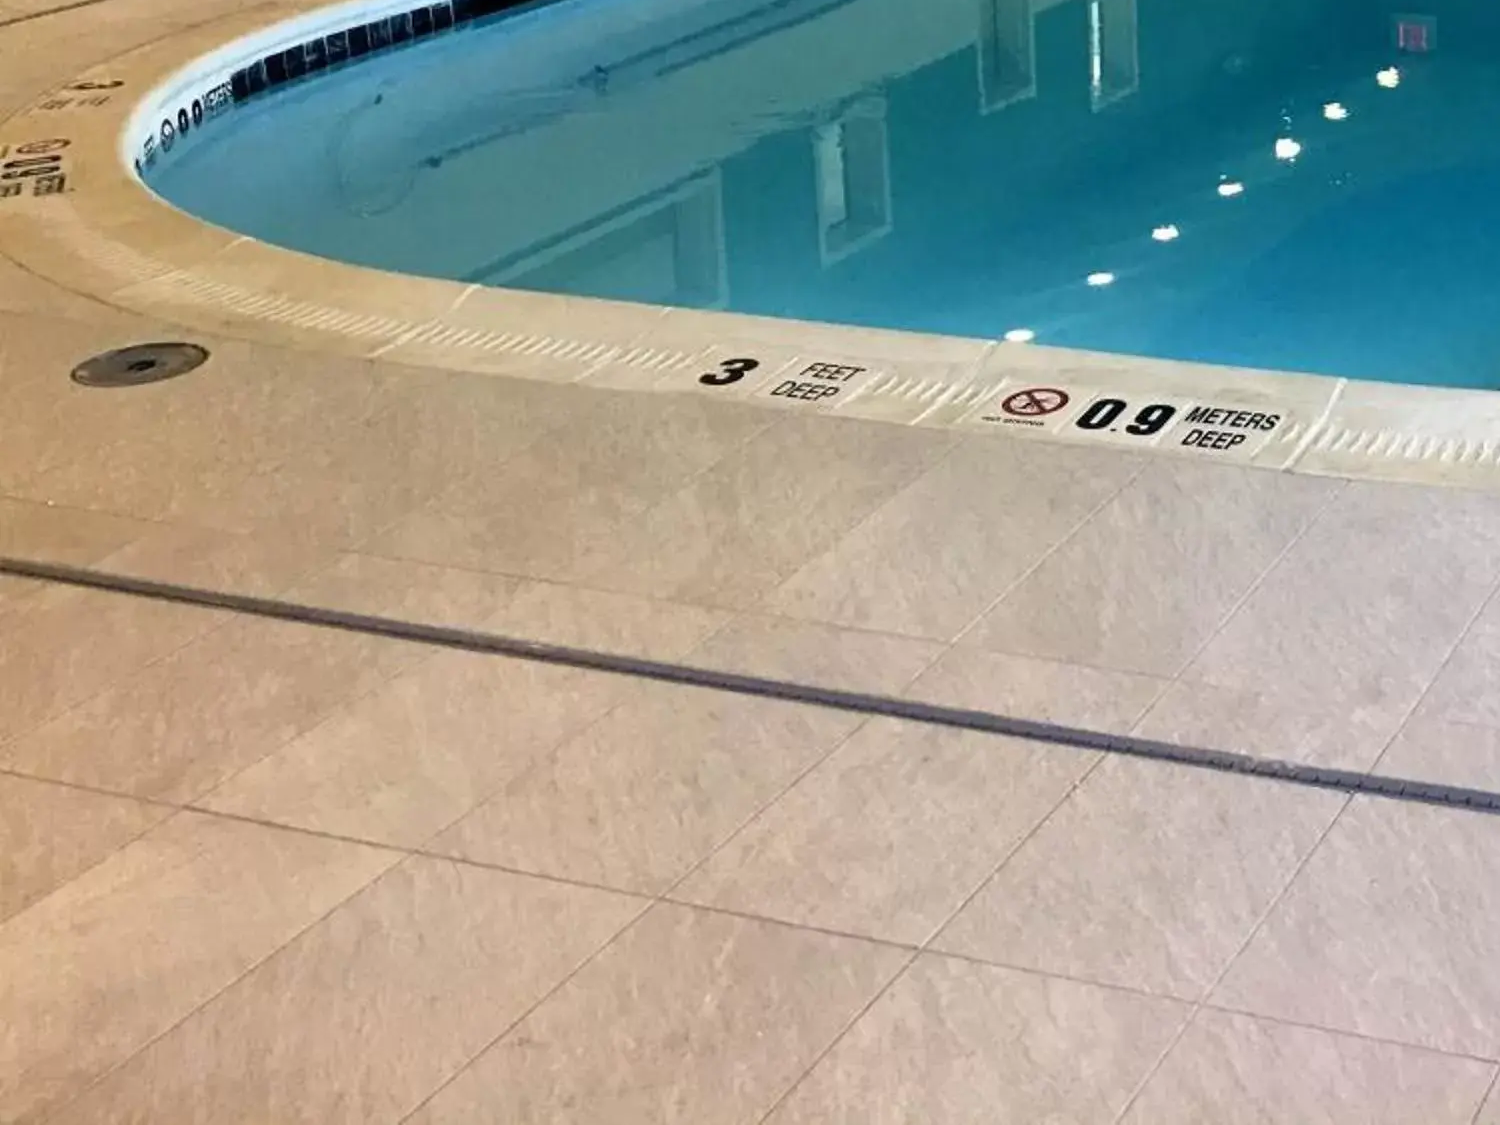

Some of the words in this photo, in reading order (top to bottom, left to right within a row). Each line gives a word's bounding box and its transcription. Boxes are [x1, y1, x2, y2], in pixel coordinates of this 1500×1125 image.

[698, 358, 760, 386] 3
[799, 362, 868, 382] FEET
[769, 380, 840, 402] DEEP
[1075, 398, 1176, 436] 0.9
[1184, 406, 1281, 431] METERS
[1180, 429, 1247, 450] DEEP
